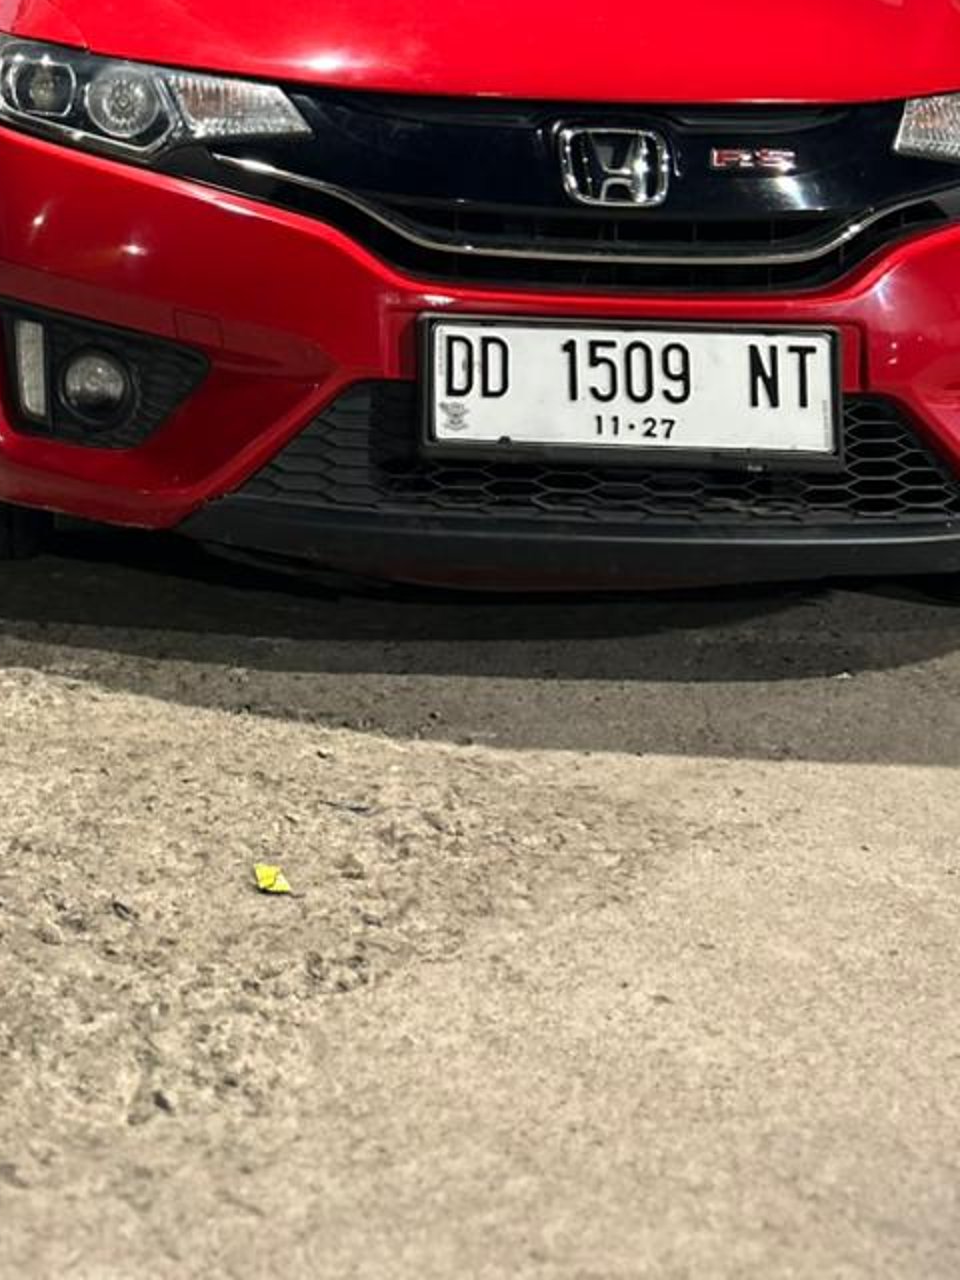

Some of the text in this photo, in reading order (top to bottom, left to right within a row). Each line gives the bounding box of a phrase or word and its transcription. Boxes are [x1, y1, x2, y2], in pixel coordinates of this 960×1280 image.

[446, 335, 509, 398] DD
[561, 339, 691, 404] 1509
[748, 345, 817, 408] NT
